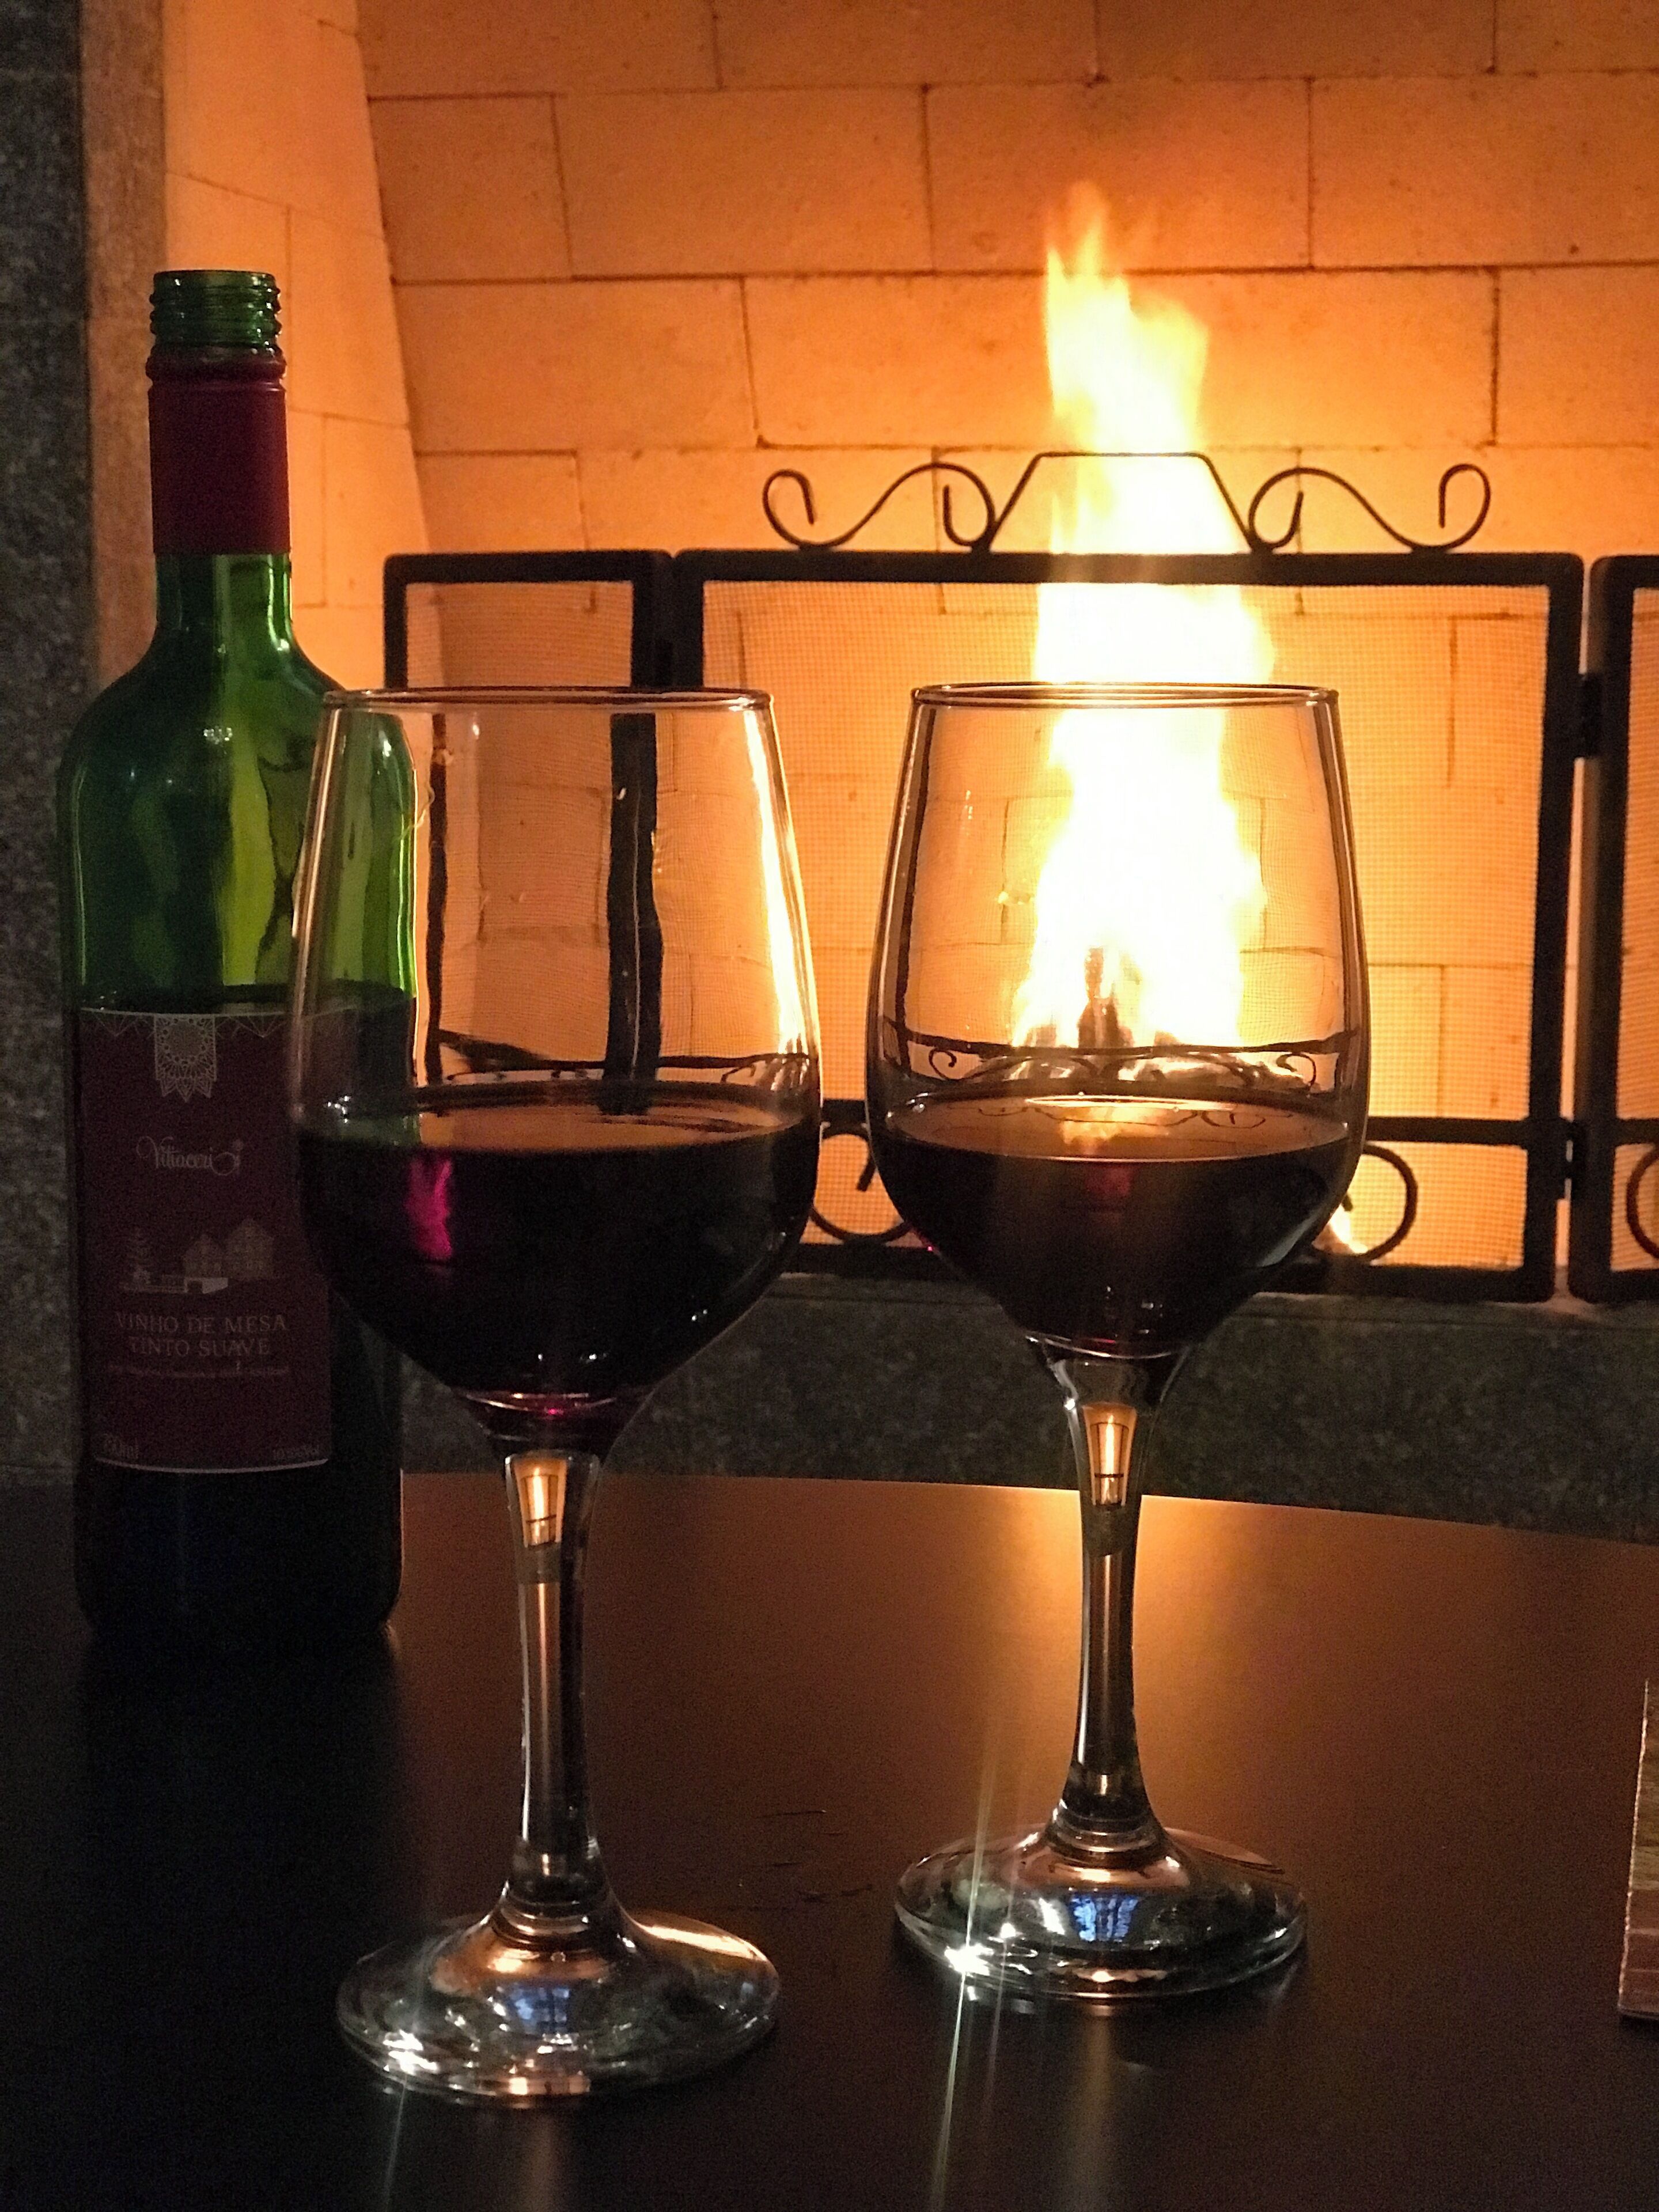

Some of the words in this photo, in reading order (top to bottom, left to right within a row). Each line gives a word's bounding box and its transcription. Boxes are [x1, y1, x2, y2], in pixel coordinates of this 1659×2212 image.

[115, 1312, 179, 1333] VINHO
[187, 1316, 215, 1334] DE
[224, 1314, 289, 1334] MESA
[128, 1336, 190, 1357] TINTO
[198, 1337, 271, 1357] SUAVE
